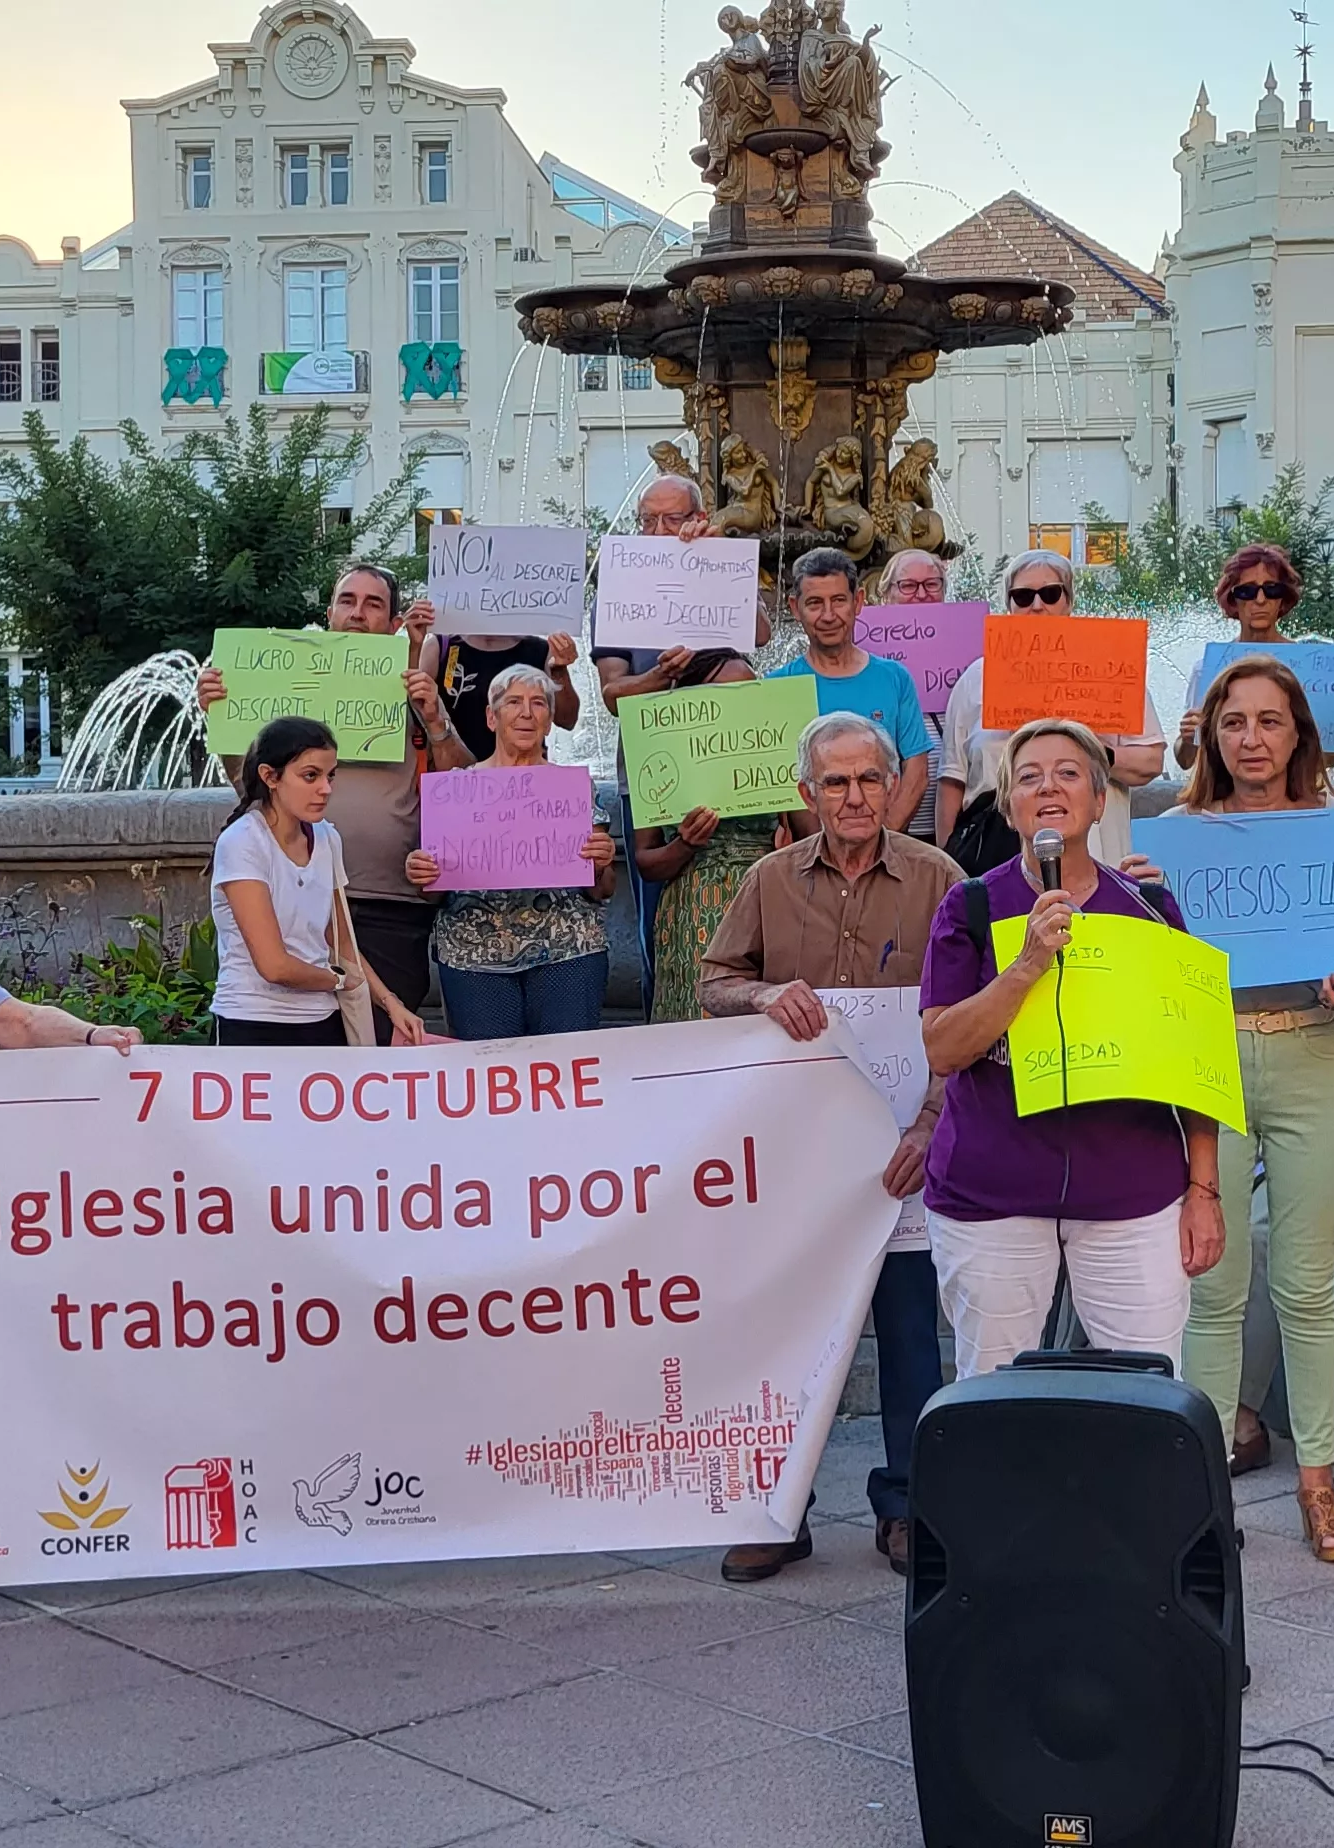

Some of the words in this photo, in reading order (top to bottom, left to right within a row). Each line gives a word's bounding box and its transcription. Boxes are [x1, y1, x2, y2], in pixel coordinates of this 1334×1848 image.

[432, 531, 493, 578] ¡NO!
[486, 562, 505, 583] AL
[513, 563, 581, 582] DESCARTE
[610, 543, 676, 569] PERSONAS
[680, 548, 755, 579] COMPROMETIDAS
[480, 586, 573, 612] EXCLUSIÓN
[605, 601, 657, 622] TRABAJO
[852, 618, 936, 645] Derecho
[235, 647, 295, 670] LUCRO
[344, 648, 393, 676] FRENO
[227, 697, 313, 721] DESCARTE
[335, 700, 408, 730] PERSONAS
[640, 699, 722, 731] DIGNIDAD
[689, 721, 788, 758] INCLUSIÓN
[430, 771, 536, 805] CUIDAR
[642, 764, 654, 780] 7
[648, 778, 676, 802] Octubre
[473, 812, 487, 823] ES
[498, 808, 516, 822] UN
[524, 799, 588, 820] TRABAJO
[1163, 864, 1291, 919] NGRESOS
[1177, 960, 1225, 995] DECENTE
[1024, 1042, 1122, 1073] SOCEDAD
[129, 1071, 163, 1122] 7
[192, 1072, 272, 1122] DE
[299, 1057, 604, 1123] OCTUBRE
[270, 1163, 492, 1235] unida
[529, 1163, 661, 1238] por
[693, 1136, 758, 1207] el
[51, 1280, 340, 1363] trabajo
[373, 1269, 701, 1344] decente
[661, 1356, 683, 1424] decente
[465, 1419, 798, 1471] #Iglesiaporeltrabajodecent
[595, 1455, 643, 1473] España
[724, 1448, 744, 1501] dignidad
[753, 1447, 788, 1490] tr
[240, 1459, 258, 1543] HOAC
[708, 1455, 728, 1514] personas
[366, 1517, 396, 1526] Obrera
[398, 1516, 436, 1526] Cristiana
[380, 1505, 420, 1516] Juventud
[40, 1534, 131, 1556] CONFER
[1051, 1818, 1086, 1834] AMS
